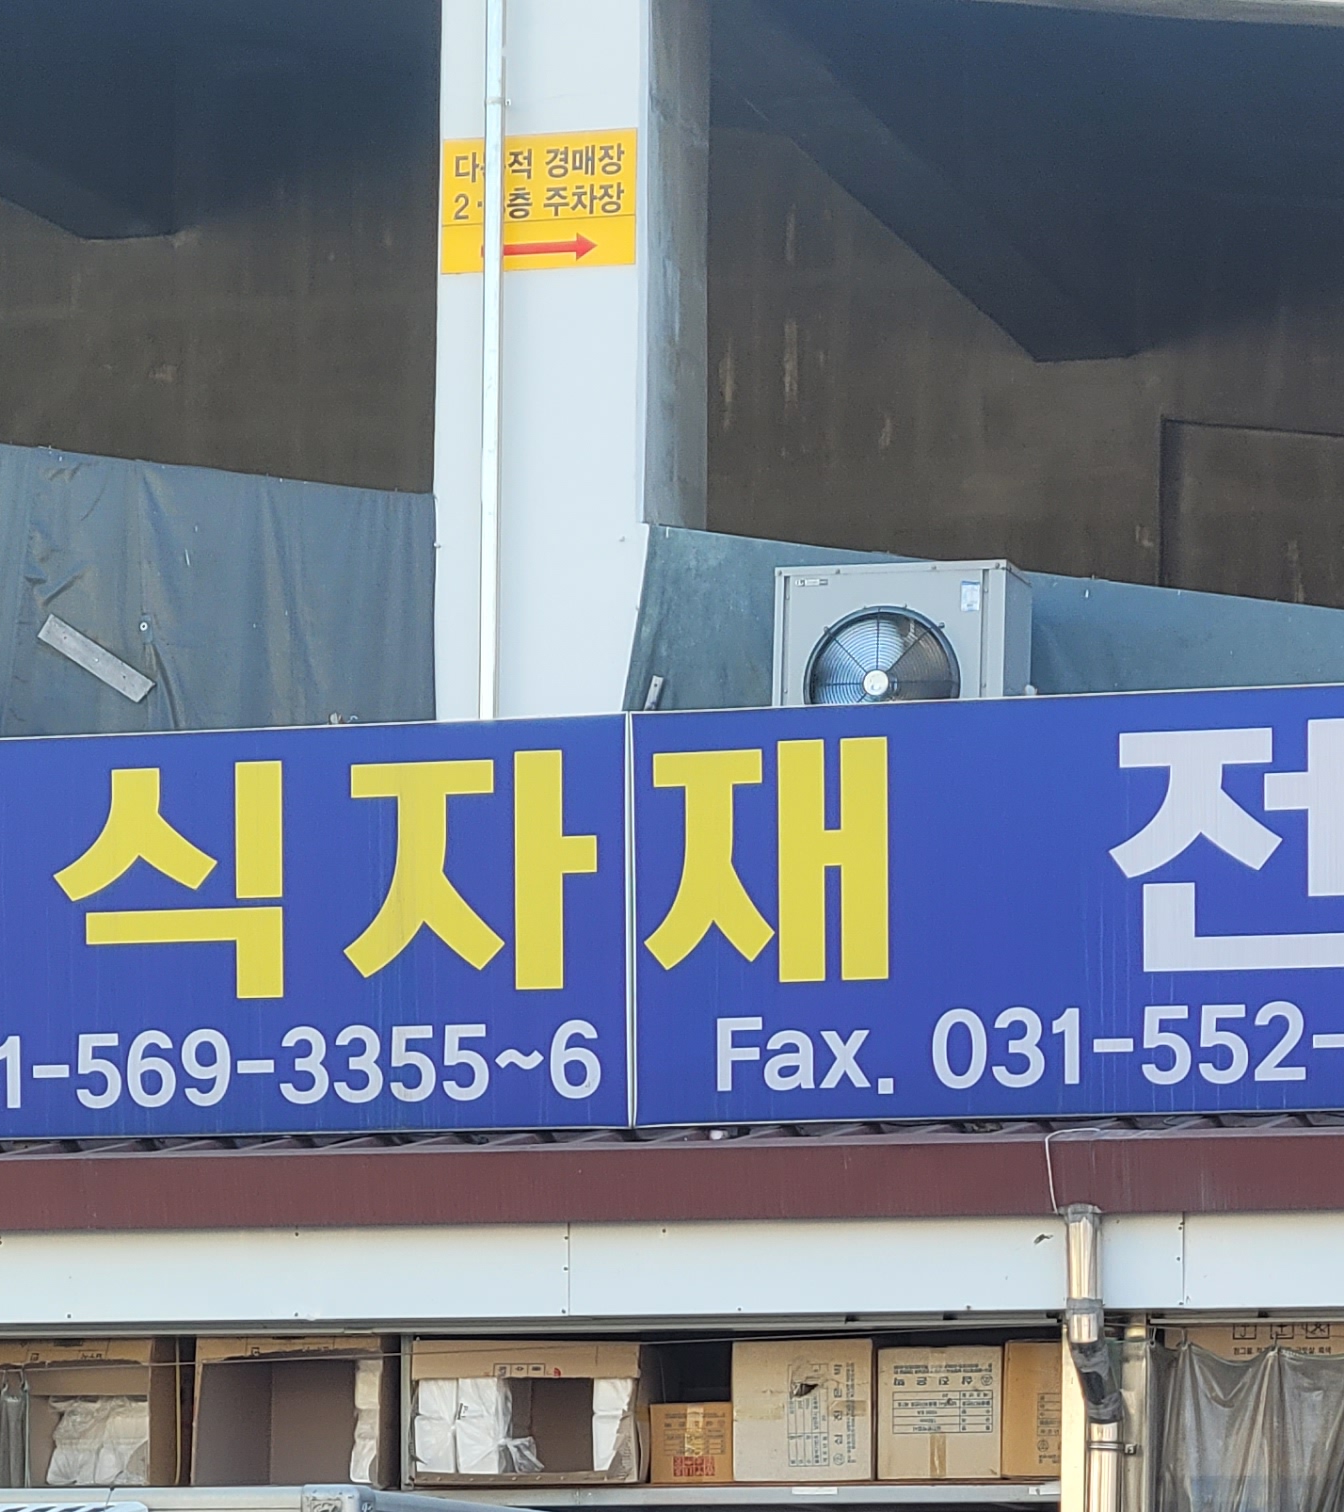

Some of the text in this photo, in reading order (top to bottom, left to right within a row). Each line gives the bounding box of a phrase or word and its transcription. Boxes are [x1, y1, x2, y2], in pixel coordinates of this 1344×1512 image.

[455, 142, 625, 183] 다적 경매장
[543, 182, 625, 218] 주차장
[53, 736, 890, 999] 식자재
[715, 1013, 897, 1096] Fax.
